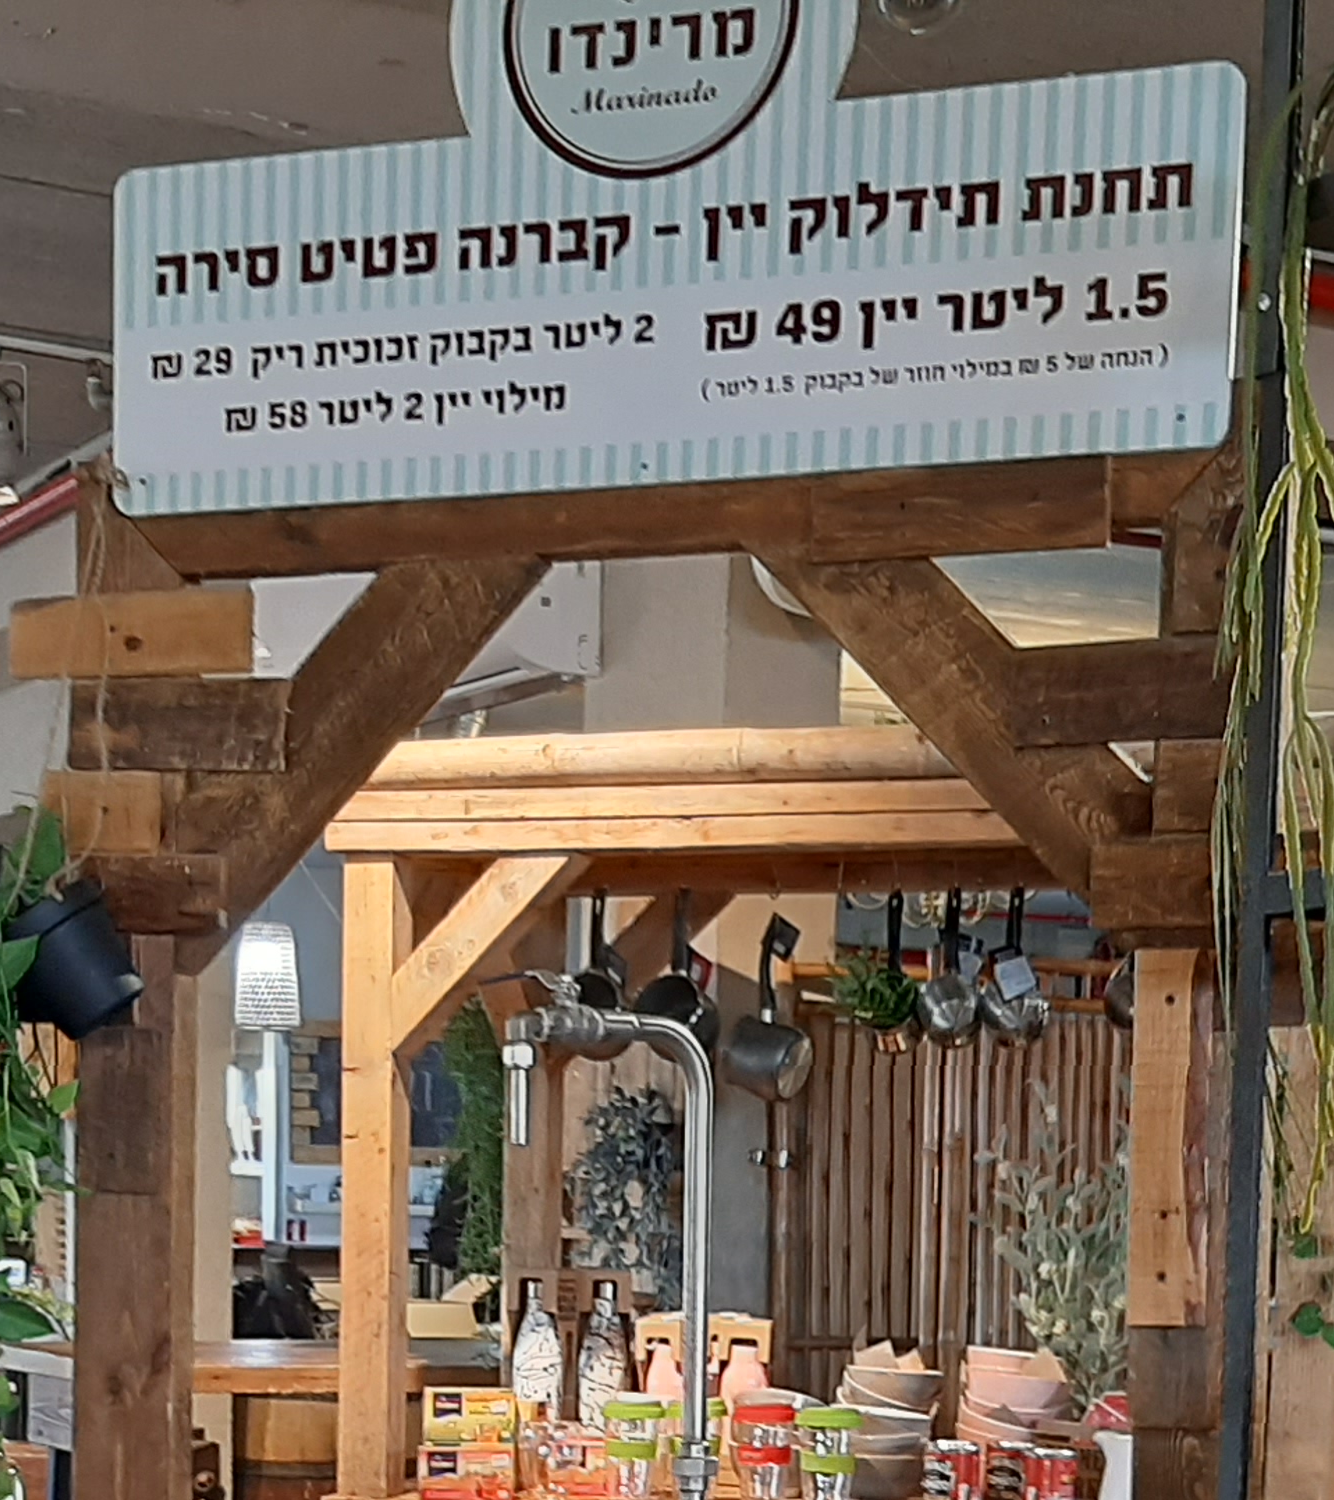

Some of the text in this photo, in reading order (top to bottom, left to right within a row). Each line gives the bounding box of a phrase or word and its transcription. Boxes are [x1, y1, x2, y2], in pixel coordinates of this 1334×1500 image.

[547, 6, 756, 75] מרינדו
[788, 179, 1001, 256] תידלוק
[1020, 161, 1194, 223] תחנת
[299, 231, 439, 284] פטיט
[457, 213, 632, 272] קברנה
[702, 201, 768, 263] יין
[154, 244, 280, 297] סירה
[704, 271, 1169, 352] 1.5 ליטר יין 49 ₪
[150, 312, 655, 381] 2 ליטר בקבוק זכוכית ריק 29 ₪
[950, 358, 1014, 380] במילוי
[1045, 354, 1059, 374] 5
[1065, 351, 1095, 371] של
[1100, 348, 1154, 370] הנחה
[714, 375, 759, 398] ליטר
[764, 374, 795, 395] 1.5
[804, 370, 865, 397] בקבוק
[868, 365, 899, 385] של
[903, 364, 946, 384] חוזר
[224, 380, 567, 434] מילוי יין 2 ליטר 58 ₪
